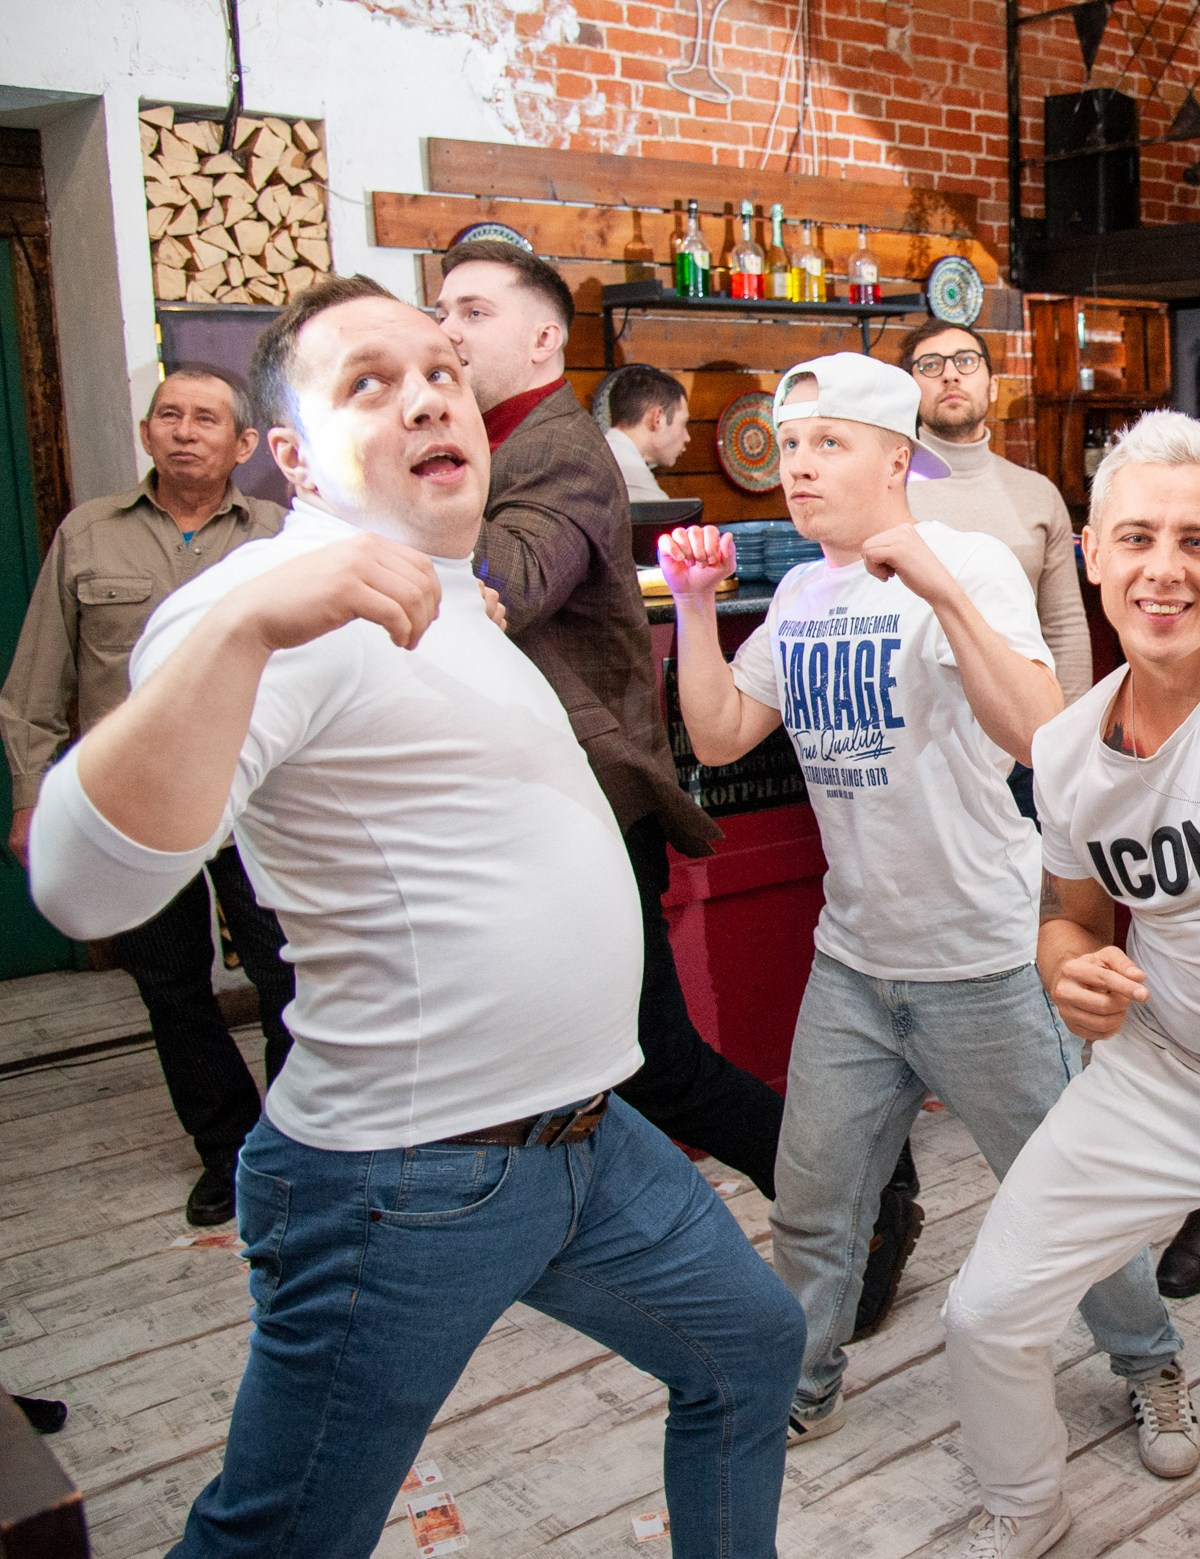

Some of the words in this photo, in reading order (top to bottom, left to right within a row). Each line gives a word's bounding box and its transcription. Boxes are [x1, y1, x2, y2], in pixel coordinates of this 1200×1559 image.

[805, 617, 848, 638] REGISTERED
[849, 613, 900, 636] TRADEMARK
[793, 730, 818, 761] True
[820, 717, 896, 762] Quality
[865, 767, 889, 787] 1978
